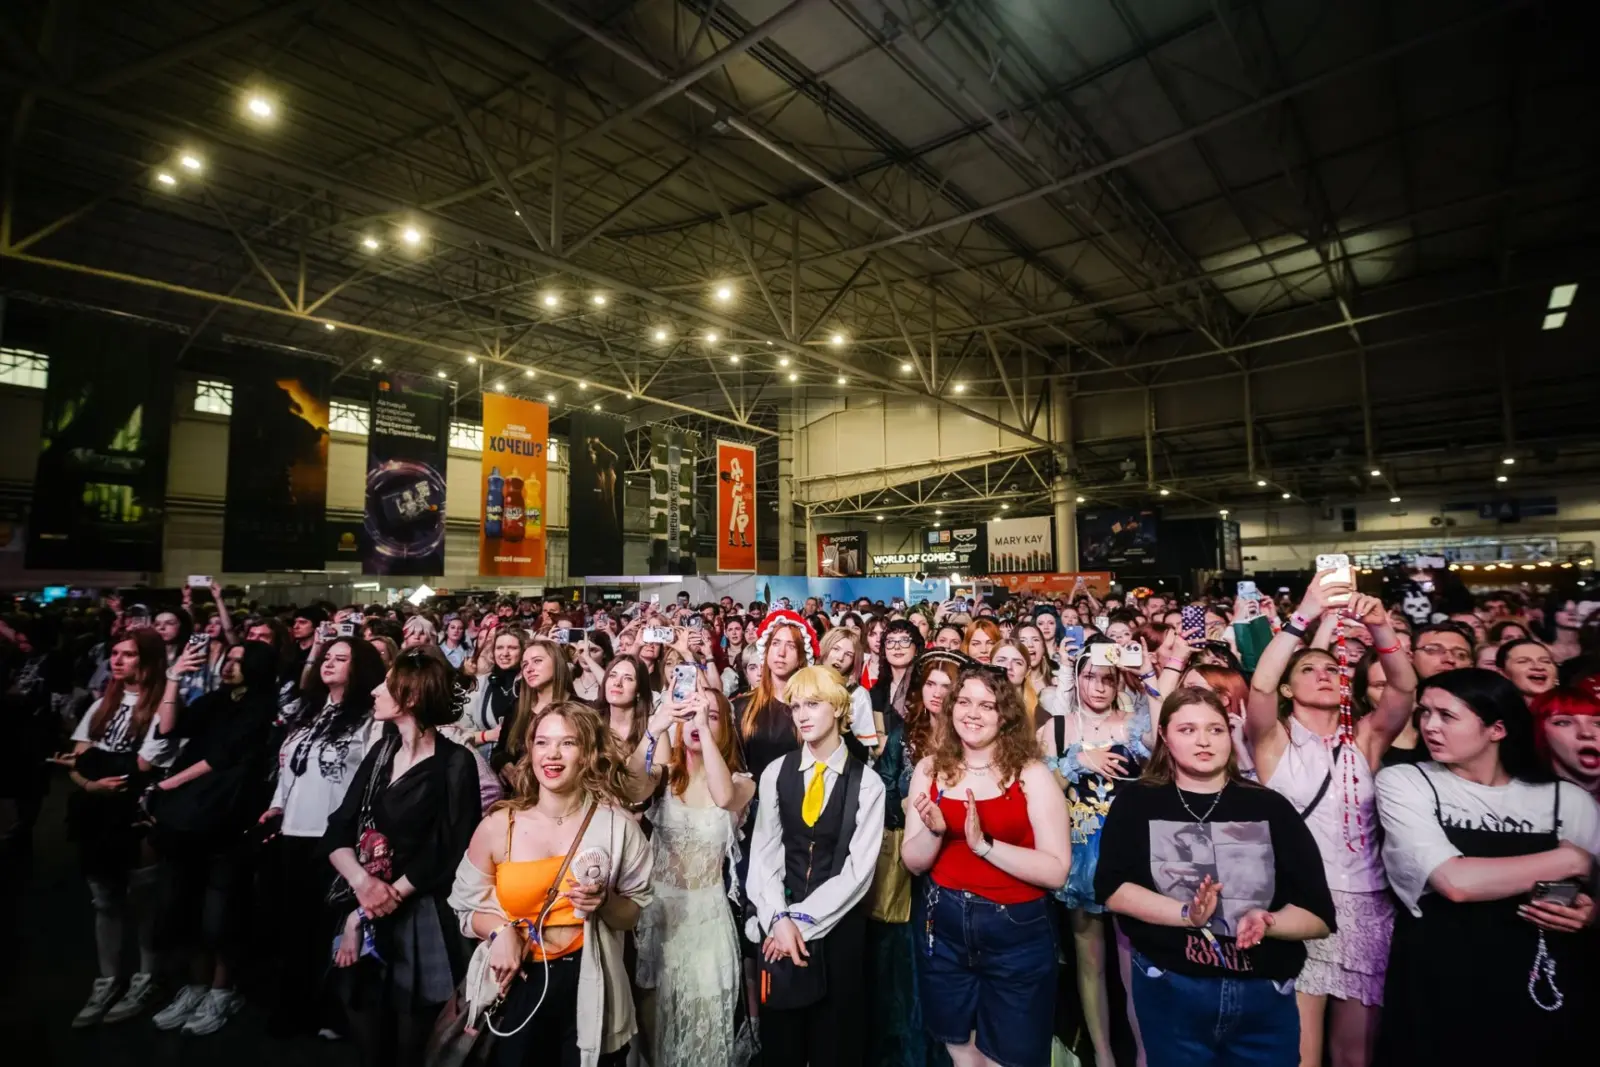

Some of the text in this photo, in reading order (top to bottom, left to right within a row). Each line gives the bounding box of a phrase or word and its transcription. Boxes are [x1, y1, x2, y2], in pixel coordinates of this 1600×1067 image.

[489, 436, 543, 458] ХОЧЕШ?
[995, 534, 1043, 546] MARY KAY
[873, 552, 957, 564] WORLD OF COMICS
